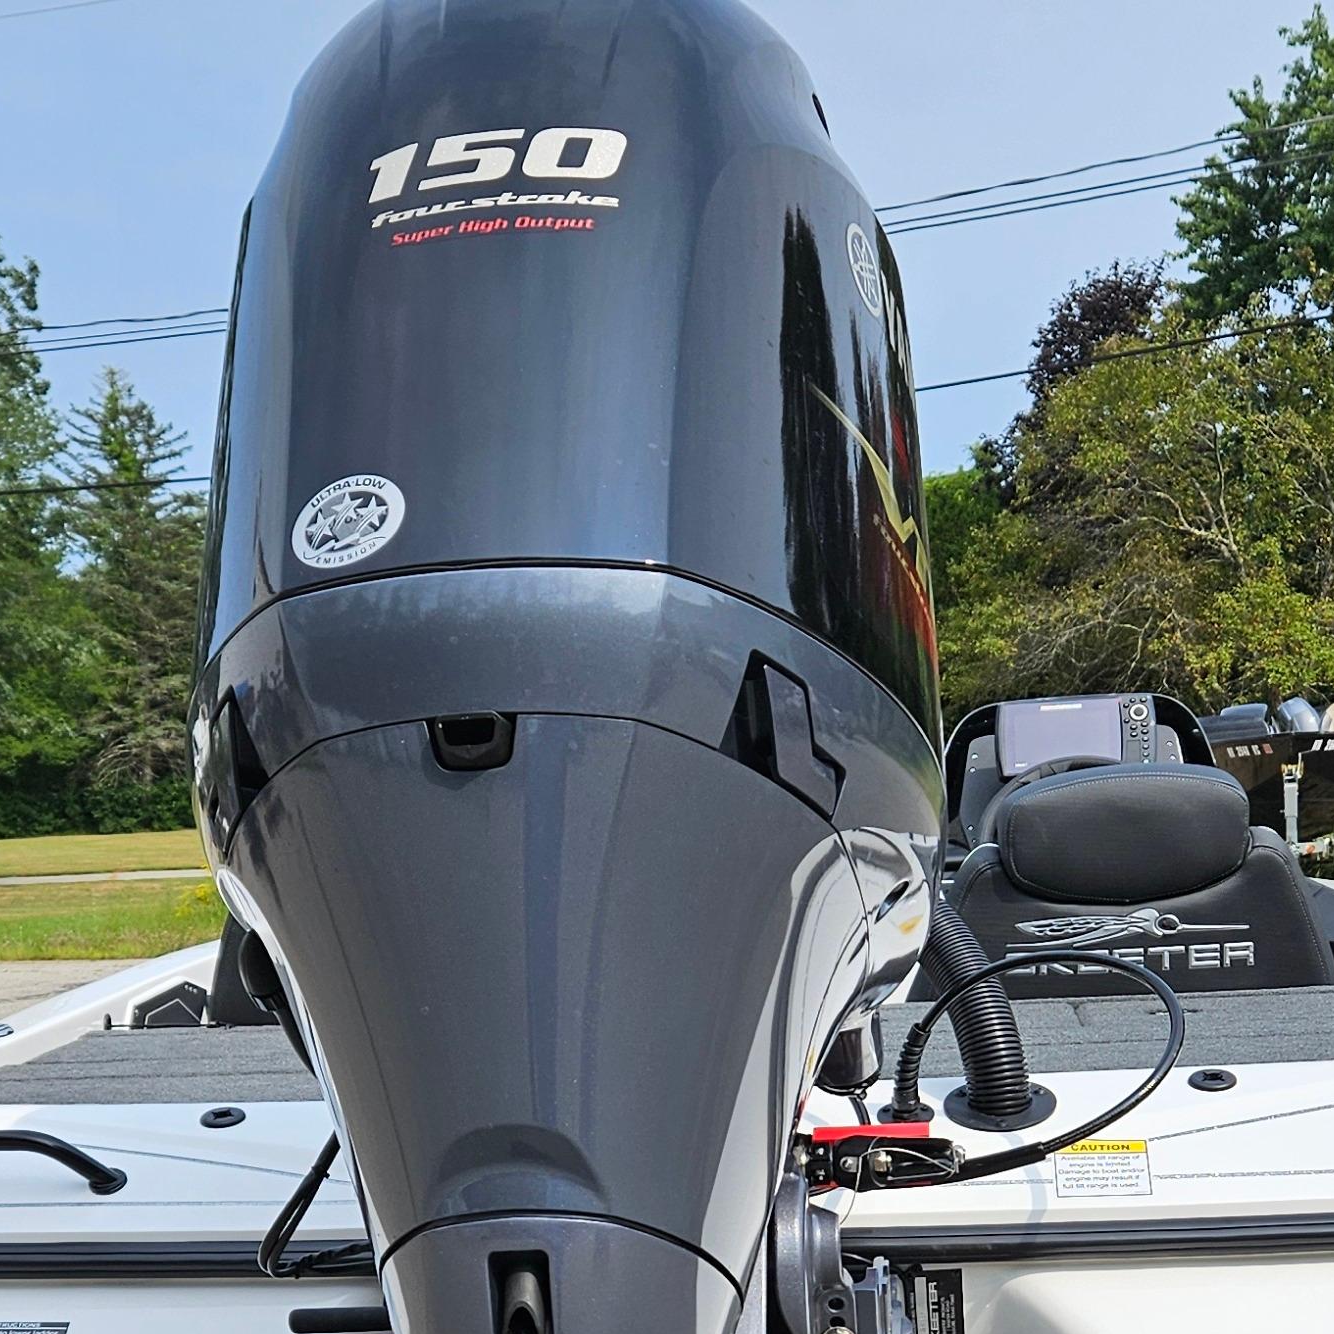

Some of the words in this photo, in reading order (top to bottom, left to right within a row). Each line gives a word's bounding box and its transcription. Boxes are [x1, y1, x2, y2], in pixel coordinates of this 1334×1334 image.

[369, 127, 628, 204] 150
[391, 224, 455, 247] Super
[458, 216, 509, 234] High
[514, 215, 596, 230] Output
[316, 541, 377, 564] EMISSION
[1070, 1144, 1131, 1152] CAUTION
